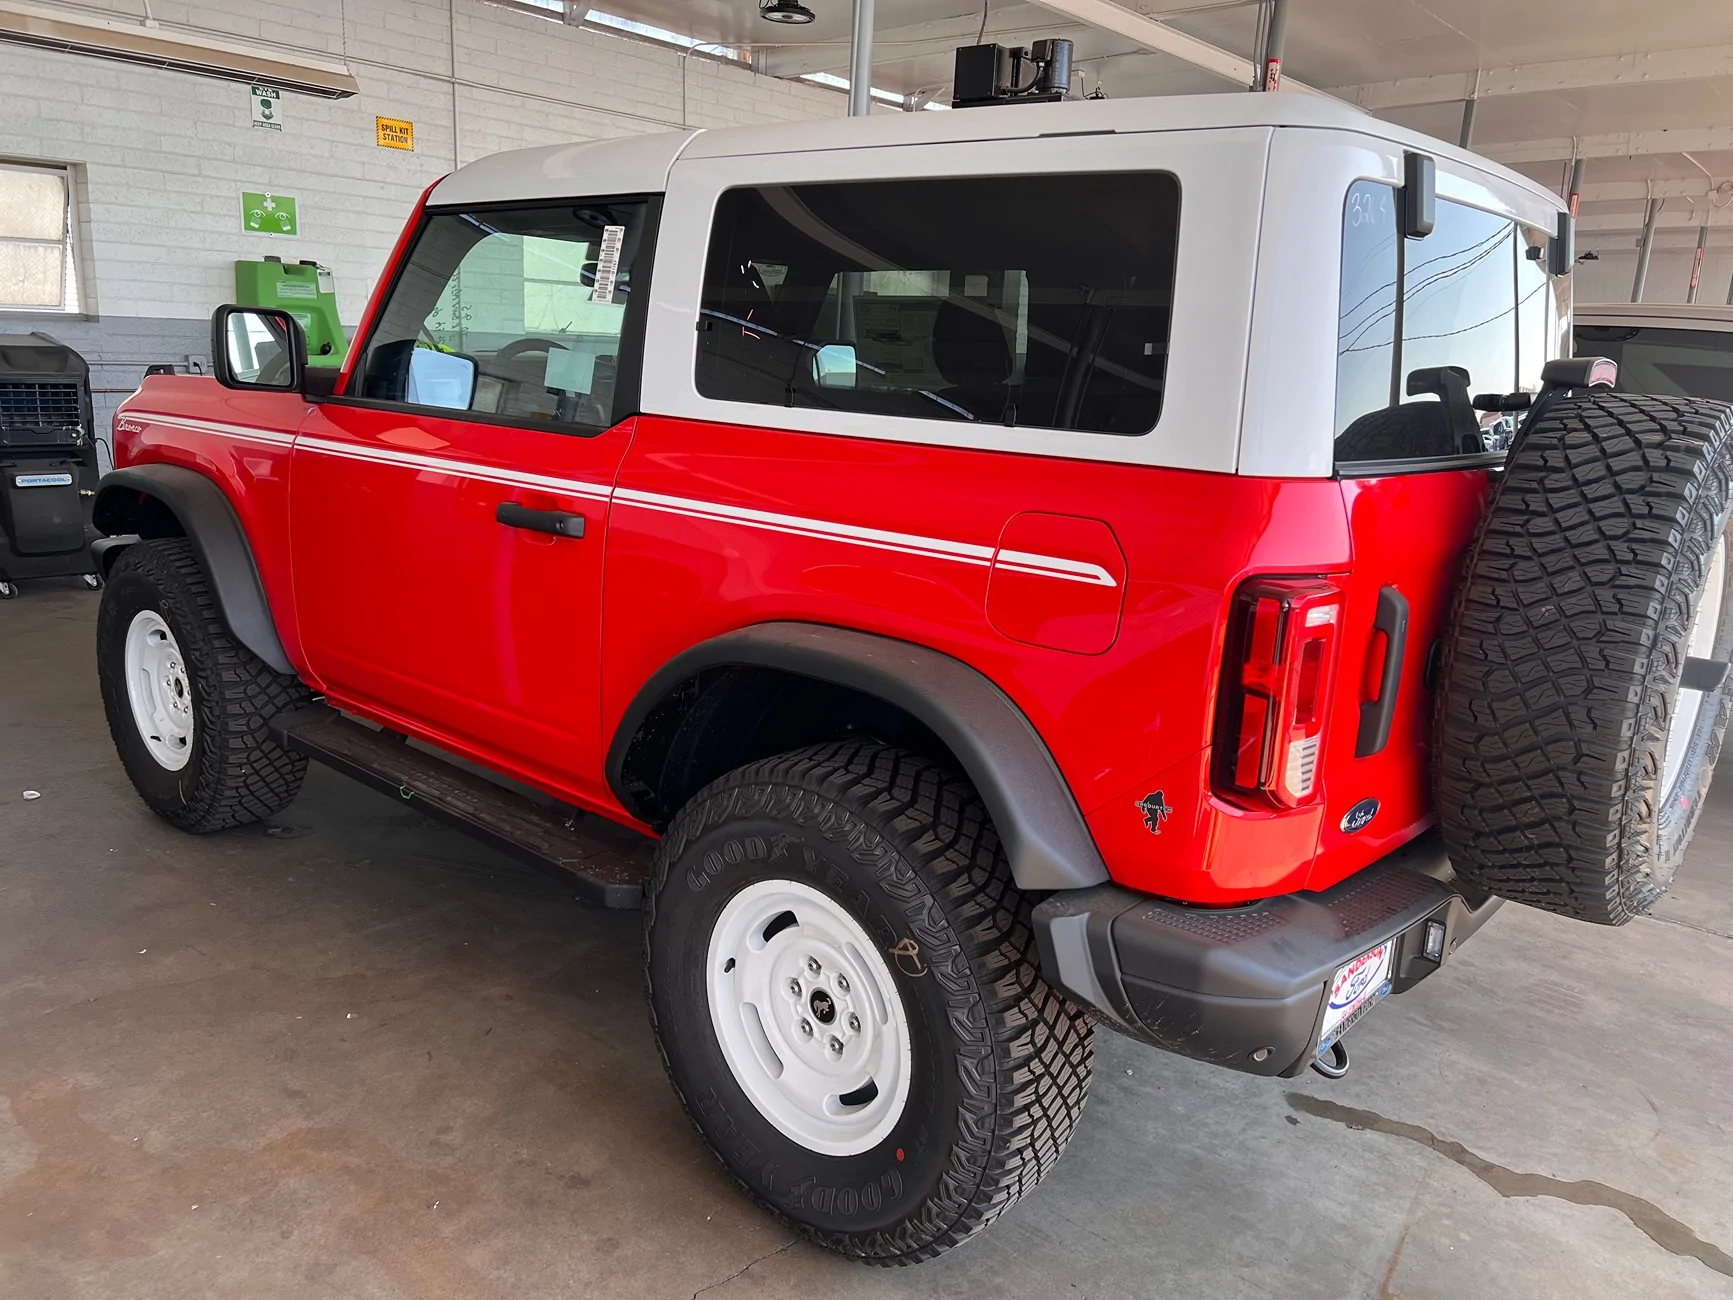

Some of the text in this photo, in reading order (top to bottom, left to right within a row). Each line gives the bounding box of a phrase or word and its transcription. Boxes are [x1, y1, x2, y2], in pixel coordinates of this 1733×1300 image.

[255, 88, 277, 98] WASH
[381, 123, 409, 136] SPILL KIT
[383, 133, 409, 144] STATION
[117, 416, 142, 433] Bronco
[1351, 808, 1375, 829] Ford
